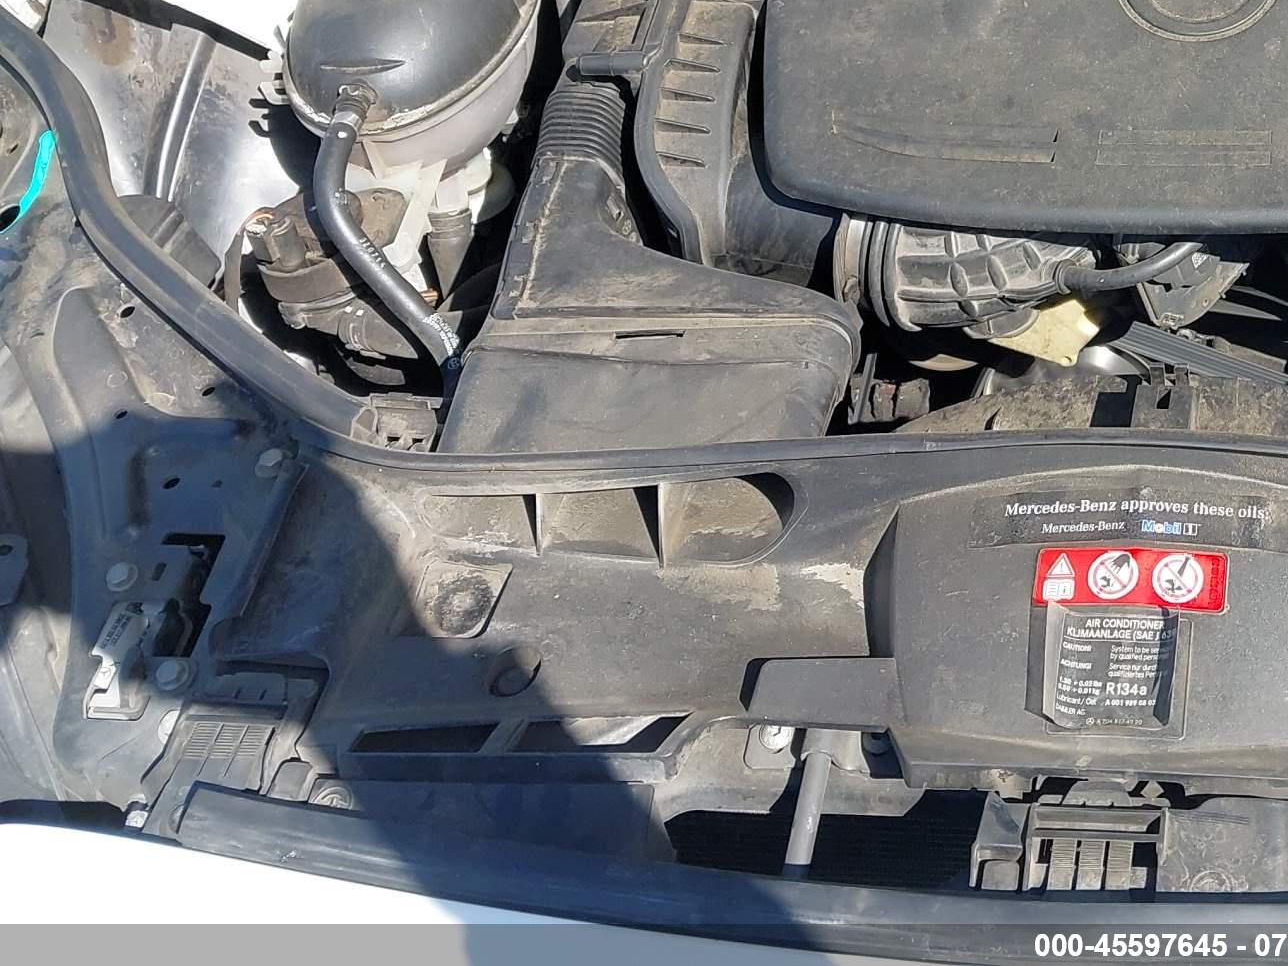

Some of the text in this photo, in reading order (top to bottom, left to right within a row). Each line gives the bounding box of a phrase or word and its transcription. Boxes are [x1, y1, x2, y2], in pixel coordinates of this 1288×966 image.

[1004, 499, 1270, 520] Mercedes-Benz approves these oils:
[1041, 520, 1126, 535] Mercedes-Benz
[1141, 520, 1182, 535] Mobil
[1085, 618, 1165, 630] AIR CONDITIONER
[1067, 626, 1131, 639] KLIMAANLAGE
[1132, 630, 1154, 640] (SAE
[1111, 645, 1133, 654] System
[1105, 682, 1148, 696] R134a
